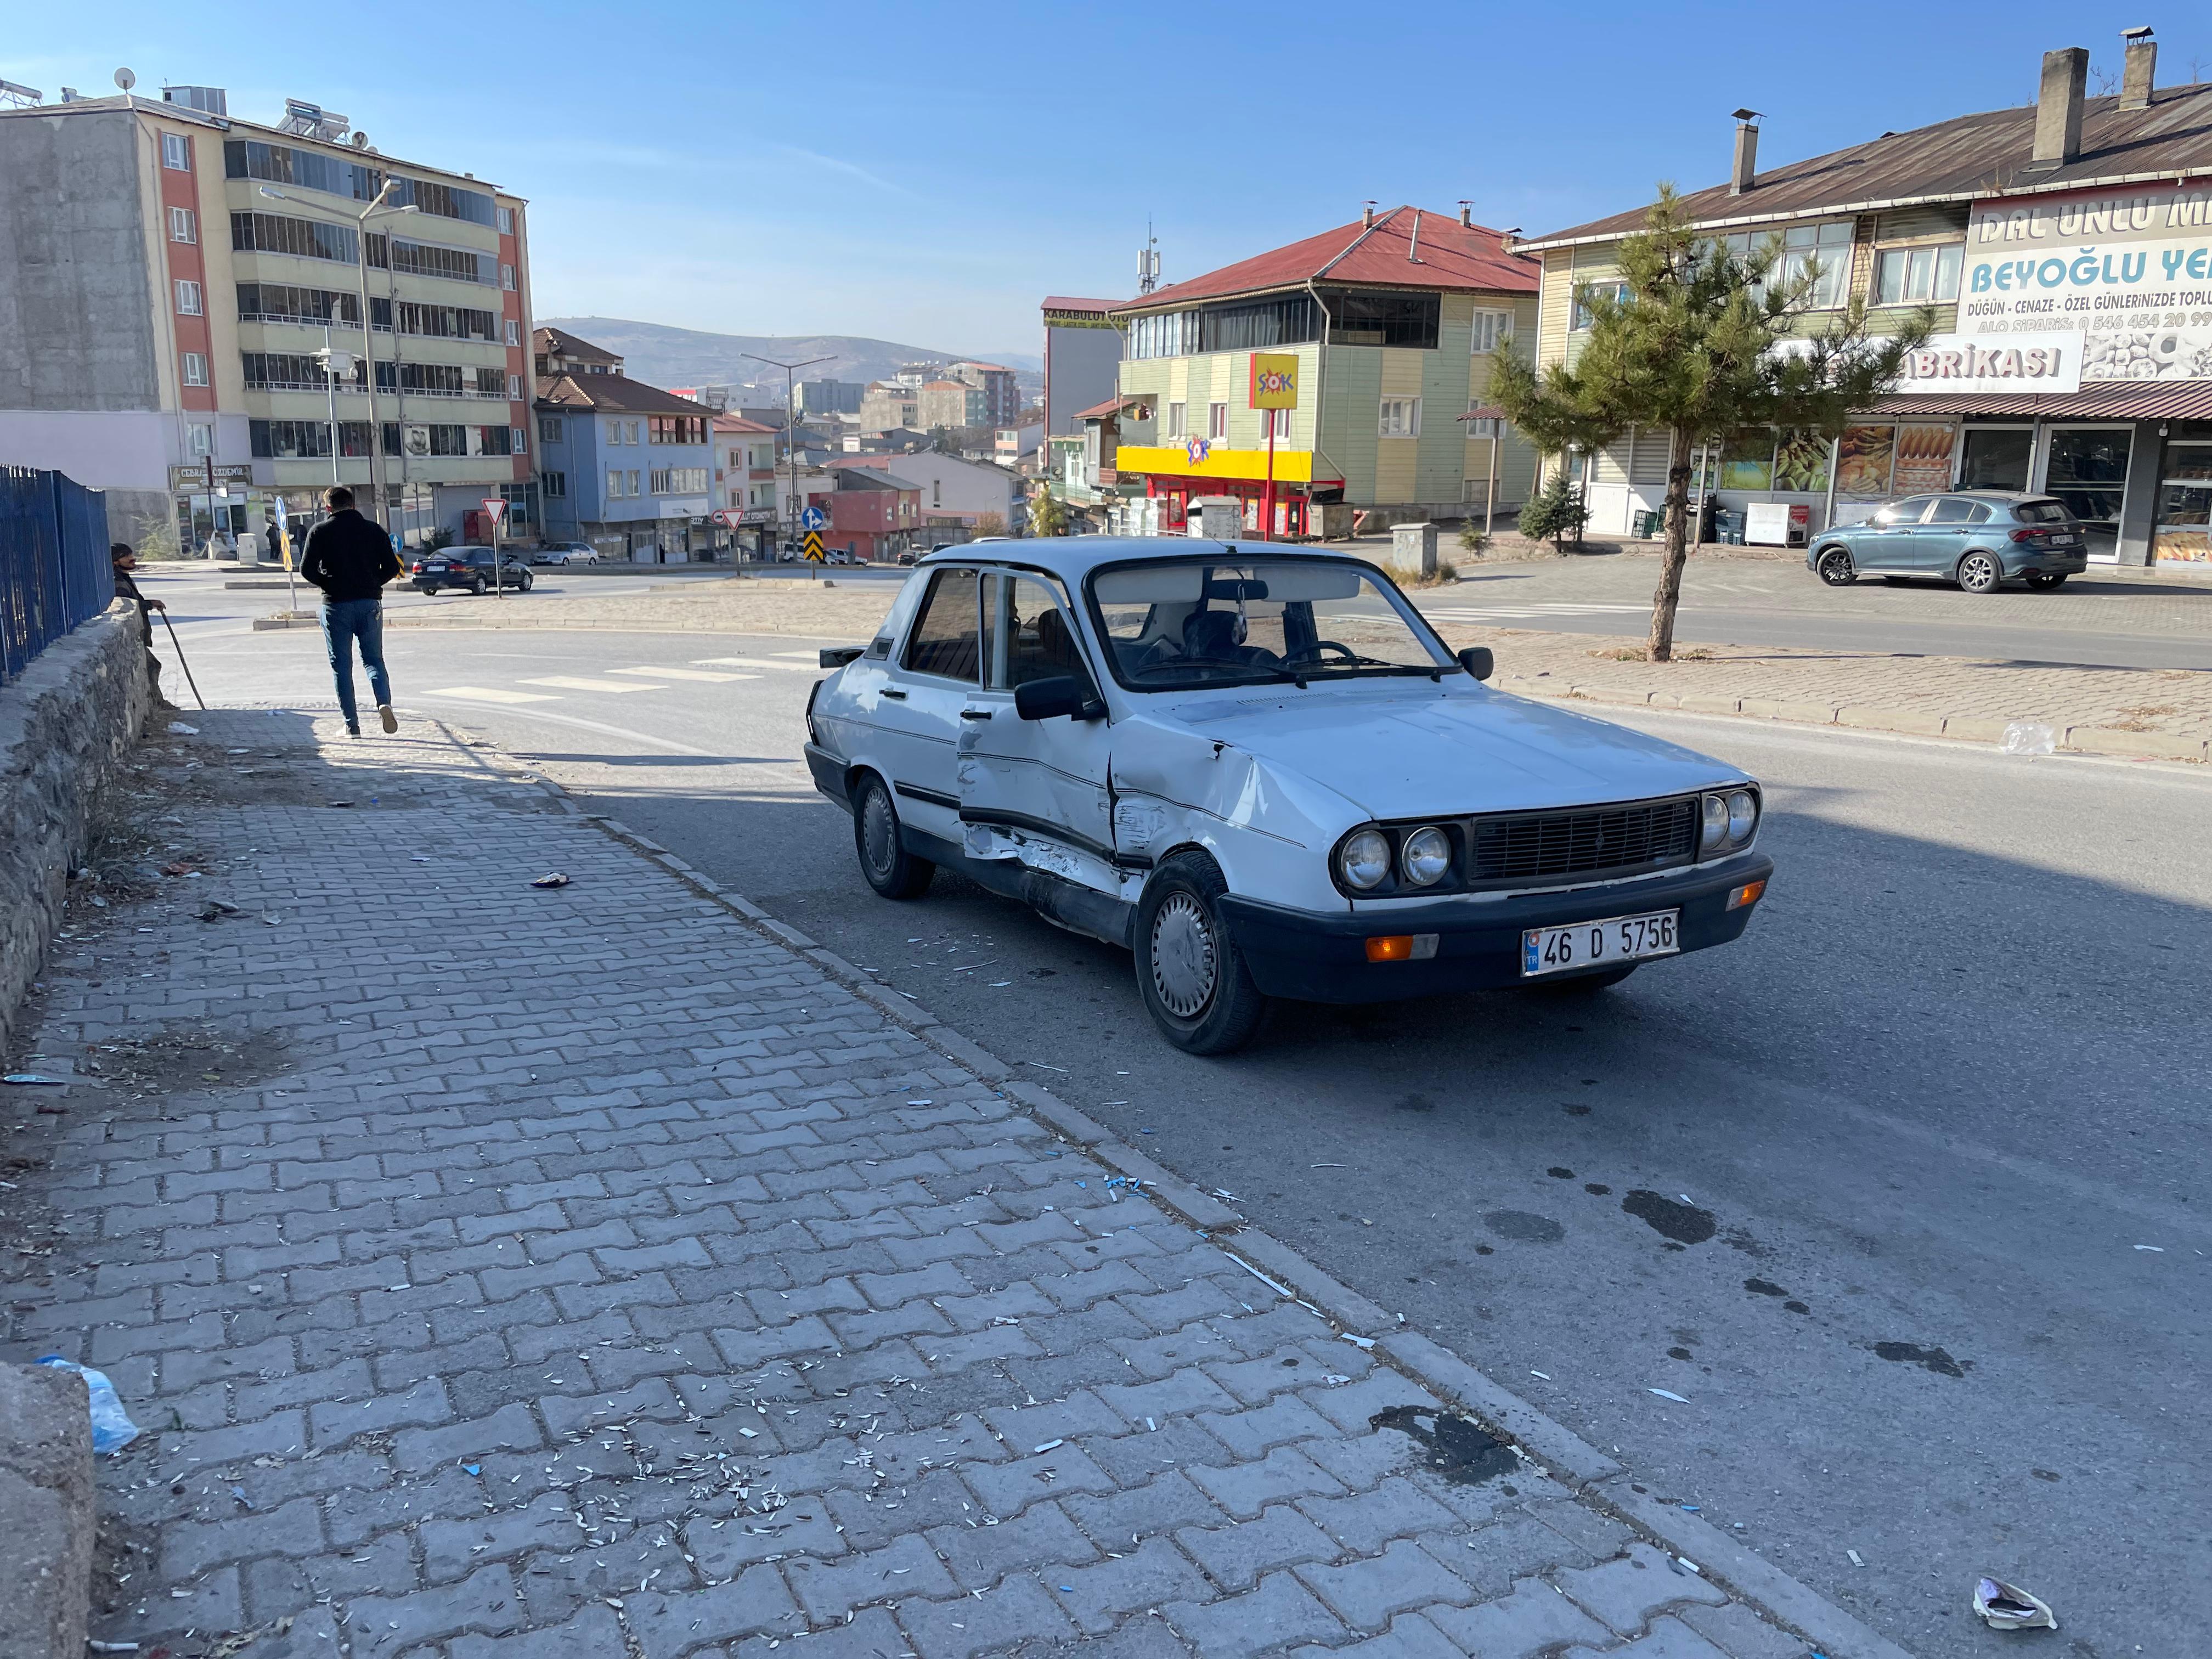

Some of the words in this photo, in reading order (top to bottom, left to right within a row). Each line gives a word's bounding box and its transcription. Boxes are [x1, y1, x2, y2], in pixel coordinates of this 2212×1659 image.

[1979, 208, 2046, 244] DAL
[2058, 197, 2157, 236] UNLU
[1971, 247, 2147, 293] BEYOĞLU
[2162, 248, 2212, 281] YE
[1044, 309, 1105, 321] KARABULUT
[1968, 298, 2005, 316] DÜĞÜN
[2015, 299, 2054, 314] CENAZE
[2064, 294, 2091, 311] ÖZEL
[1977, 320, 2008, 333] ALO
[2079, 317, 2089, 330] 0
[2093, 315, 2123, 330] 546
[2128, 313, 2159, 328] 454
[2163, 312, 2186, 328] 20
[2191, 312, 2212, 326] 99
[1895, 343, 2060, 379] ABRİKASI
[1259, 373, 1294, 397] ŞOK
[1188, 439, 1209, 467] ŞOK
[1544, 932, 1572, 964] 46
[1592, 928, 1603, 958] D
[1622, 916, 1673, 953] 5756
[1526, 955, 1538, 965] TR
